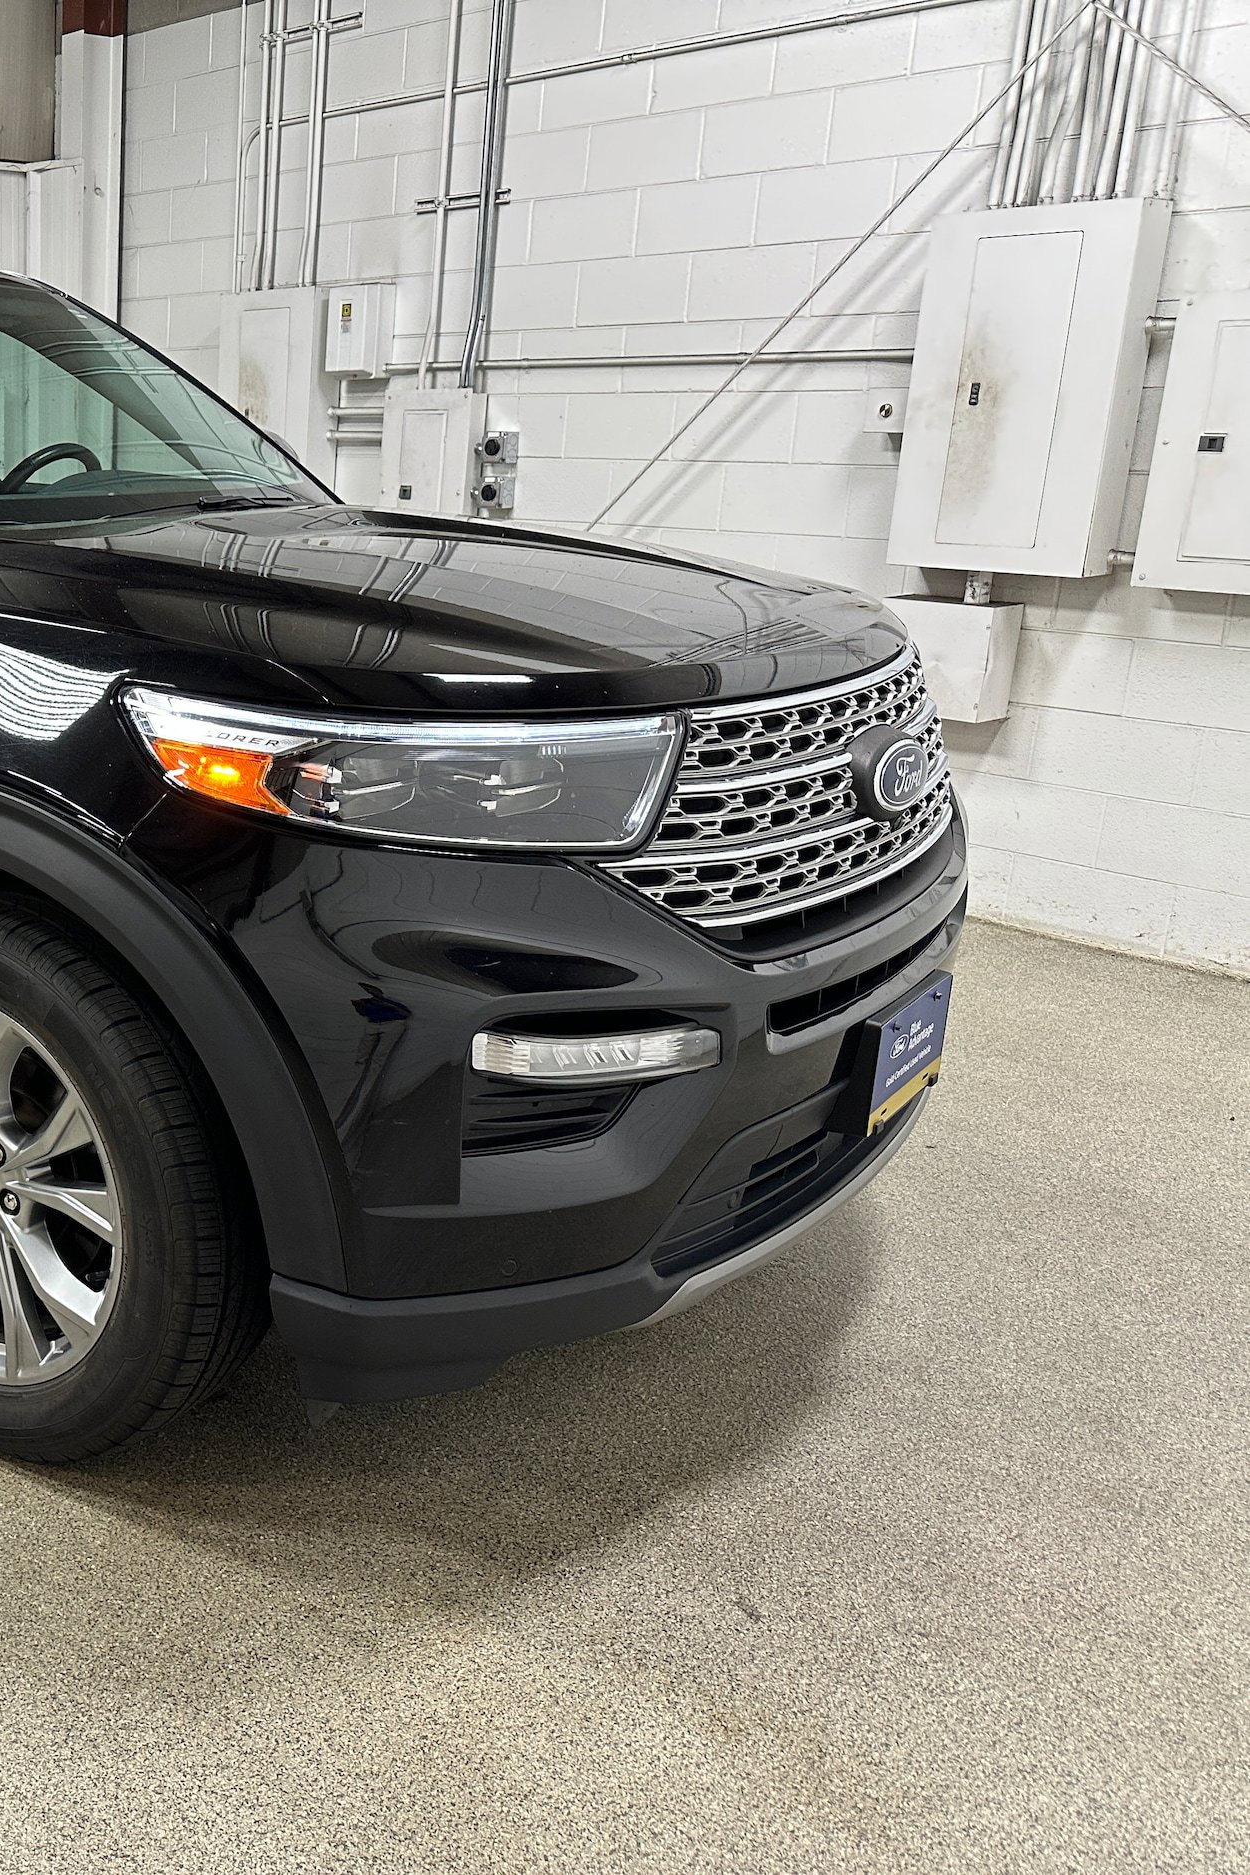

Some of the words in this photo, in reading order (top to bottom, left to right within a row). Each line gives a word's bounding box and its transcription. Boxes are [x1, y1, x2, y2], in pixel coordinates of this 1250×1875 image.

[204, 730, 280, 747] LORER
[894, 754, 923, 797] Ford
[908, 1023, 934, 1051] Advantage
[910, 1019, 922, 1037] Blue
[893, 1038, 906, 1056] Ford
